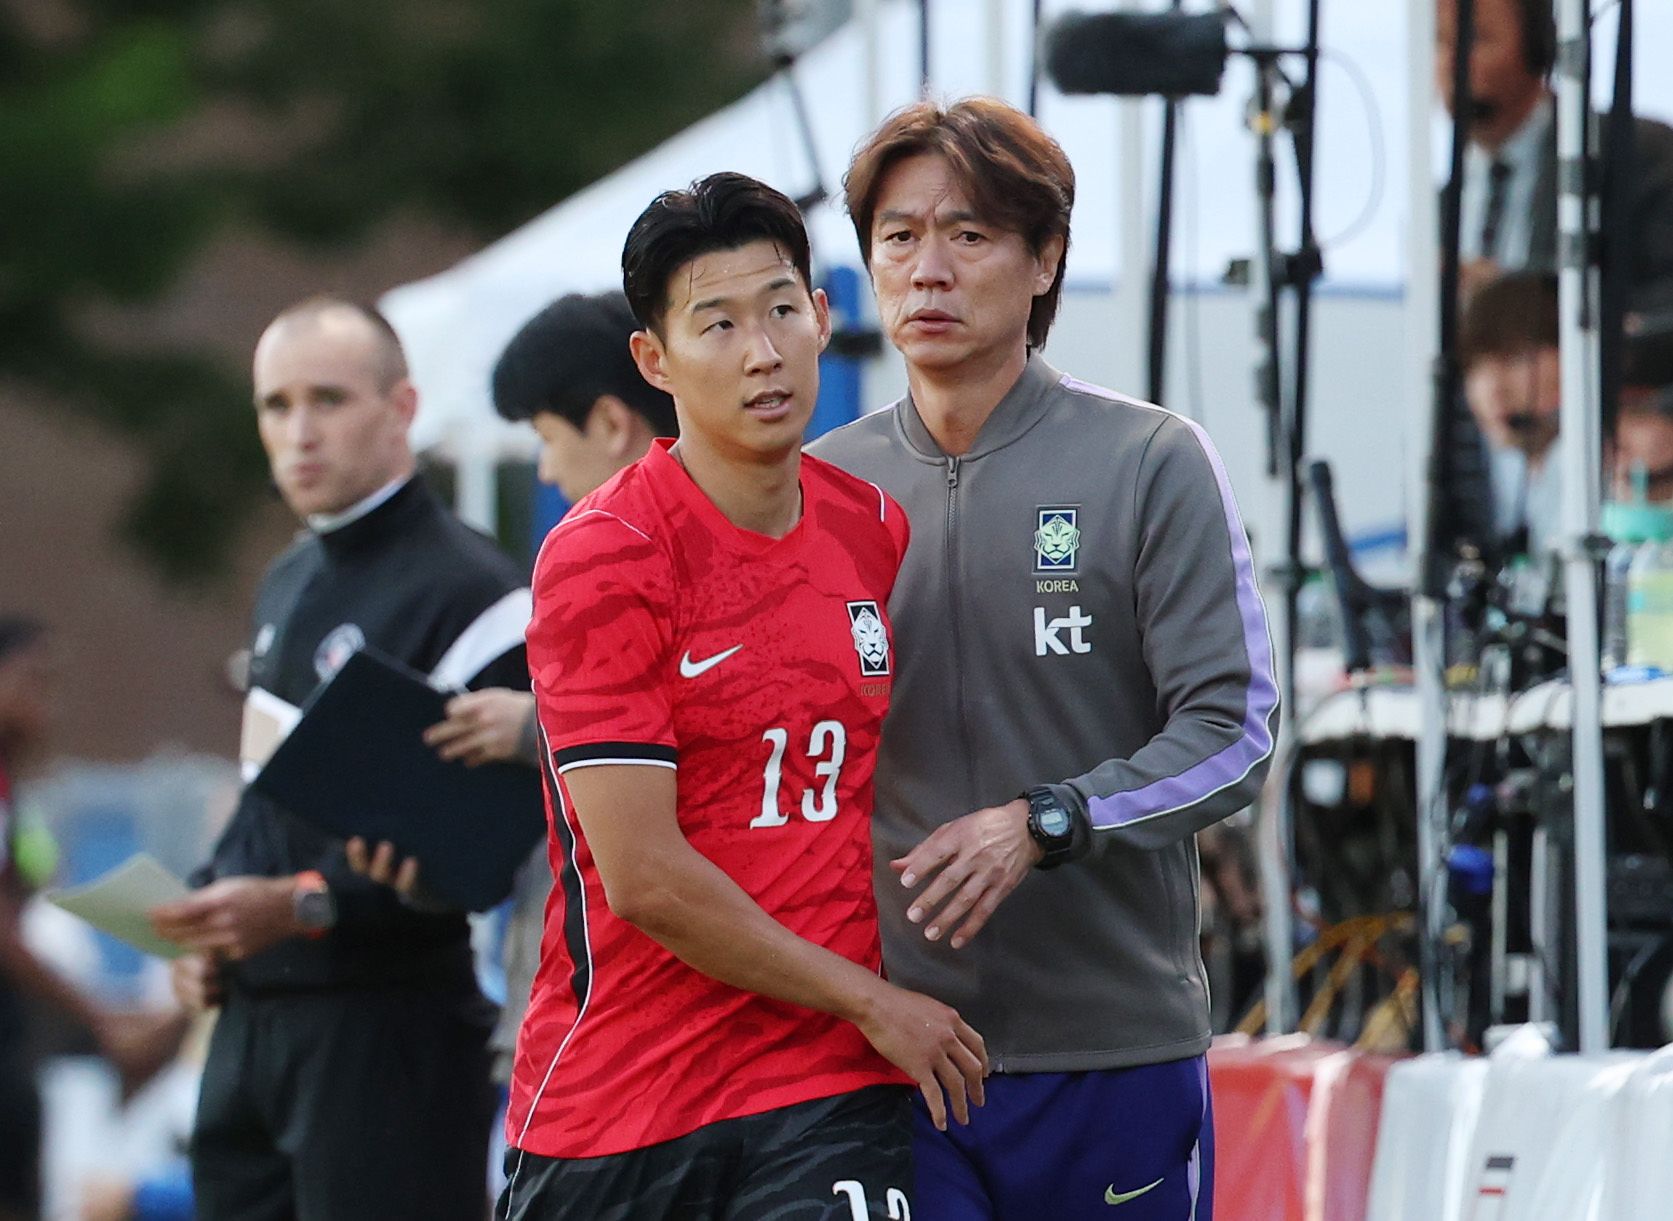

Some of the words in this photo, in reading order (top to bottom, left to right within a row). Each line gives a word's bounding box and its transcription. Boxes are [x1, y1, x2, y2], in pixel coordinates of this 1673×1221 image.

[1036, 580, 1079, 593] KOREA
[1034, 605, 1092, 656] kt
[749, 719, 847, 830] 13
